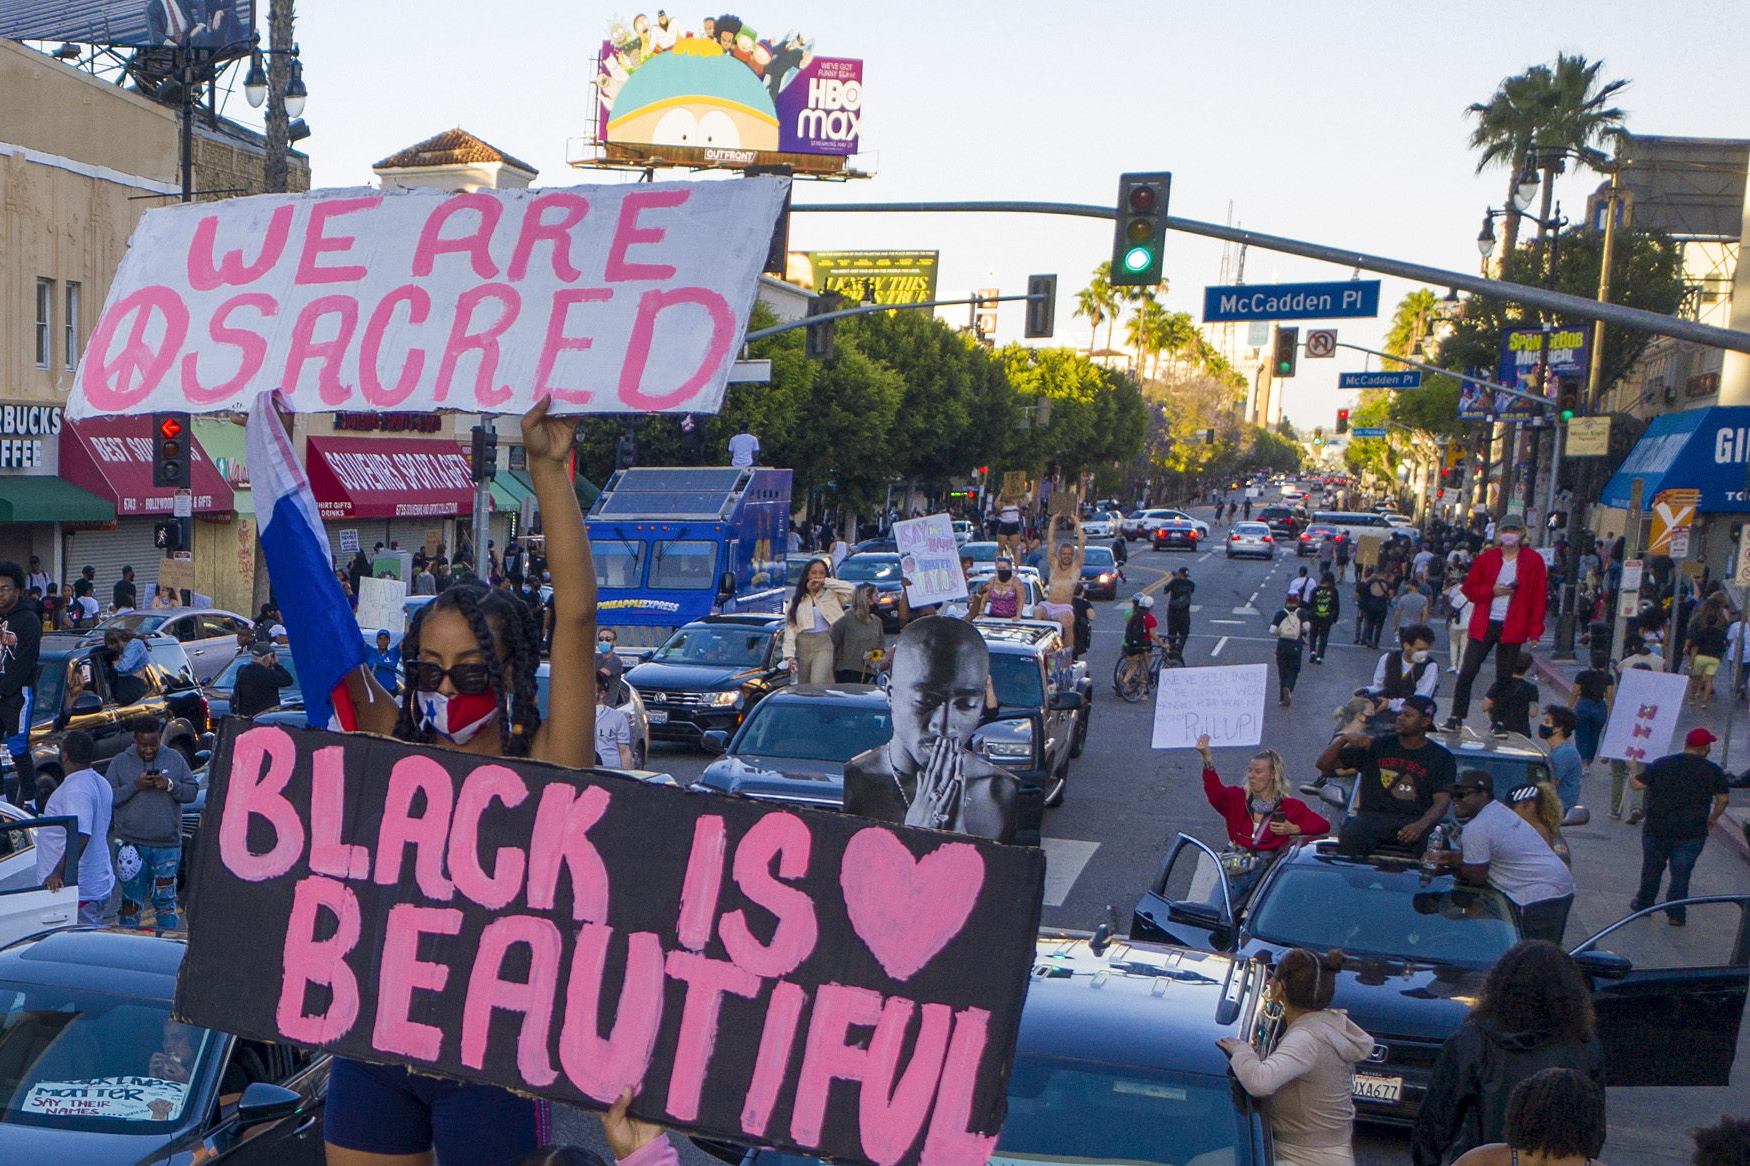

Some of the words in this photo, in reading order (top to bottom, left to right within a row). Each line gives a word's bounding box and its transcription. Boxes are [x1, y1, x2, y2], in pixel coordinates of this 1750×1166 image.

[808, 77, 862, 111] HBO
[797, 108, 865, 141] max
[706, 149, 753, 160] OUTFRONT
[186, 195, 384, 291] WE
[412, 188, 691, 284] ARE
[889, 276, 928, 290] THIS
[886, 290, 930, 304] TRUE
[1220, 293, 1331, 314] McCadden
[1342, 290, 1362, 309] Pl
[180, 283, 737, 409] SACRED
[1346, 374, 1399, 385] McCadden
[90, 437, 132, 462] BEST
[123, 498, 136, 510] 6743
[145, 497, 174, 510] HOLLYWOOD
[198, 496, 211, 508] GIFTS
[321, 509, 344, 517] DRINKS
[901, 520, 927, 548] SAY
[218, 725, 612, 924] BLACK
[676, 812, 817, 979] IS
[31, 1097, 62, 1107] SAY
[70, 1100, 111, 1108] THEIR
